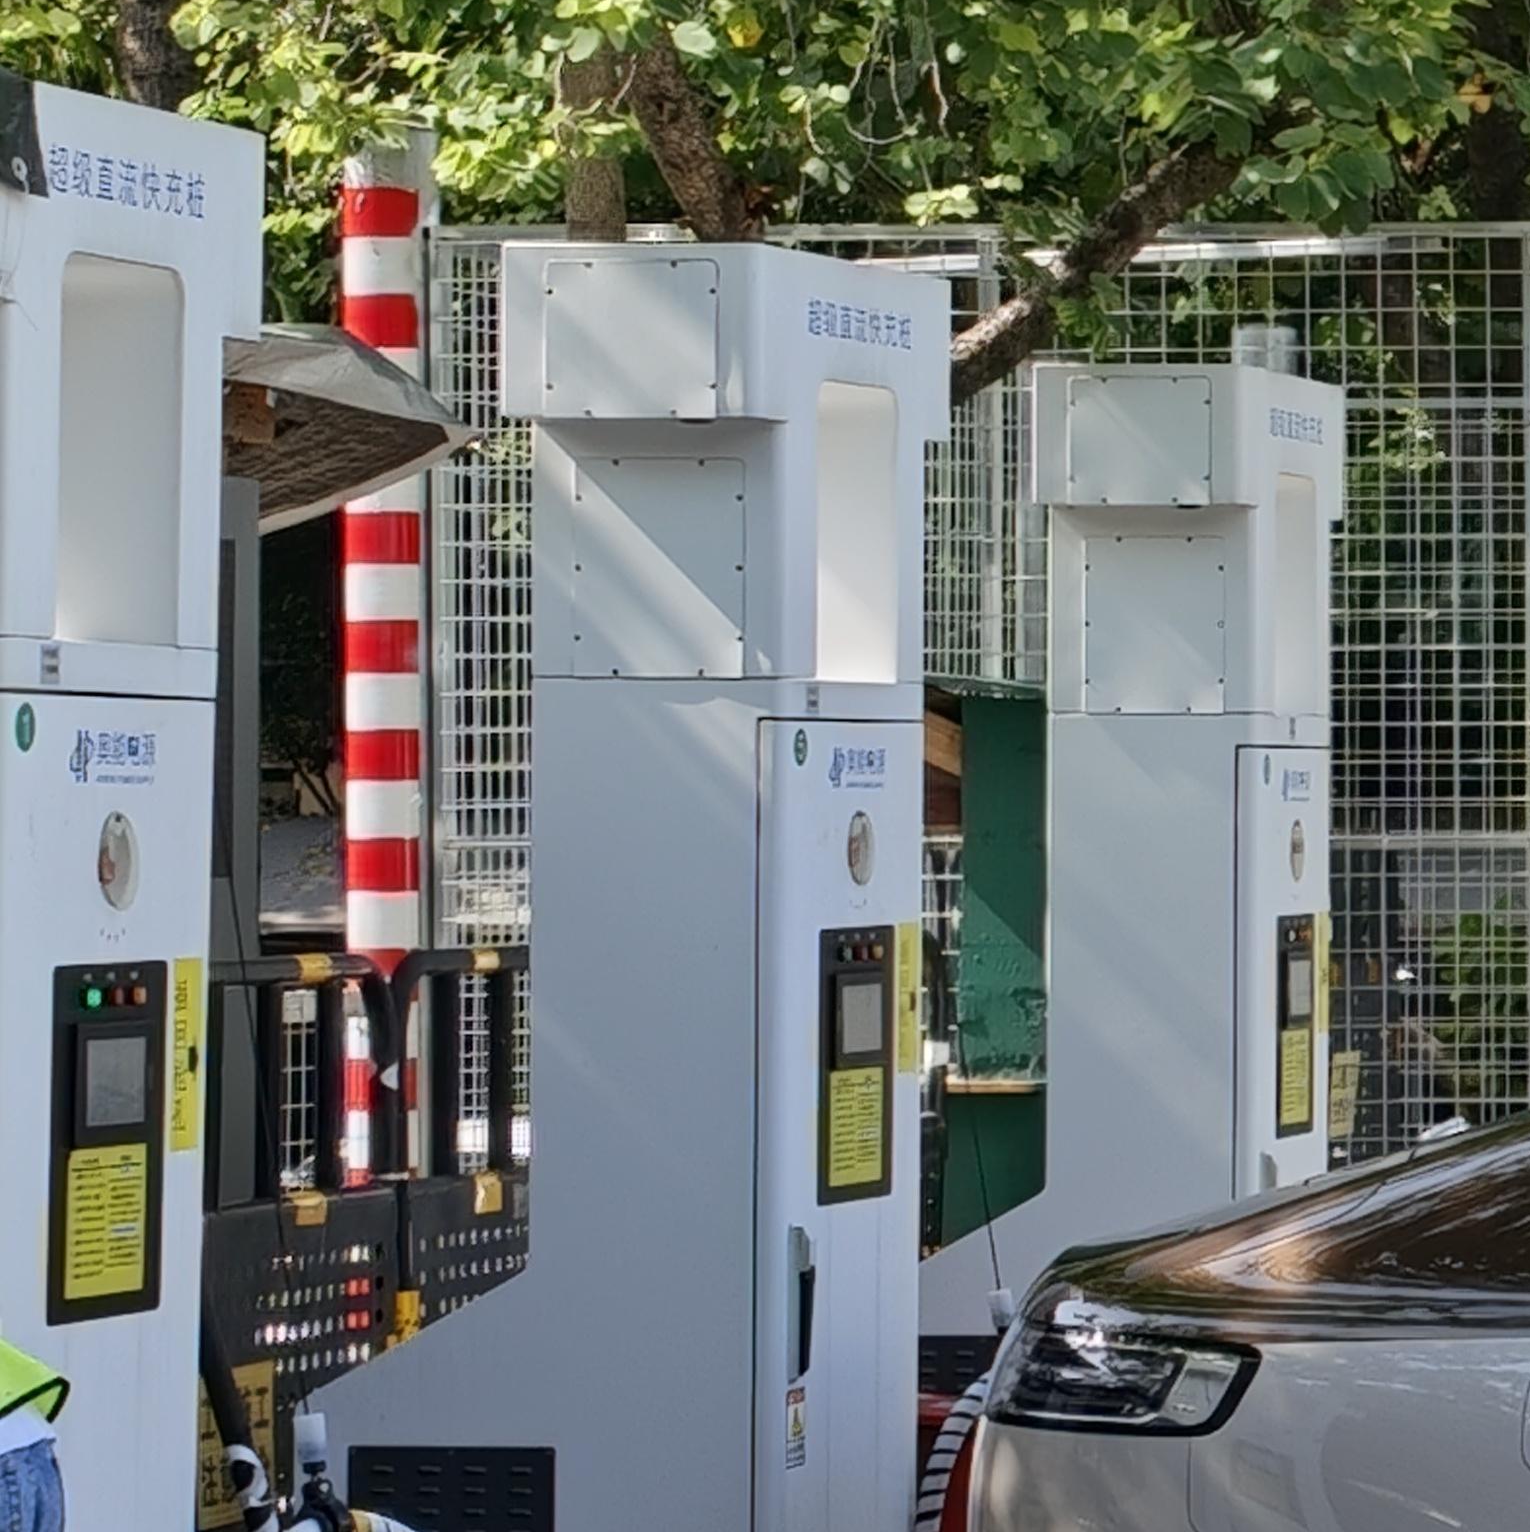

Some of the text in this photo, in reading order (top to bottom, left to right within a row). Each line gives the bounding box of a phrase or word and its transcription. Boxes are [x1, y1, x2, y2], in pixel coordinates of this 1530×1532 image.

[49, 144, 205, 219] 超级直流快充桩
